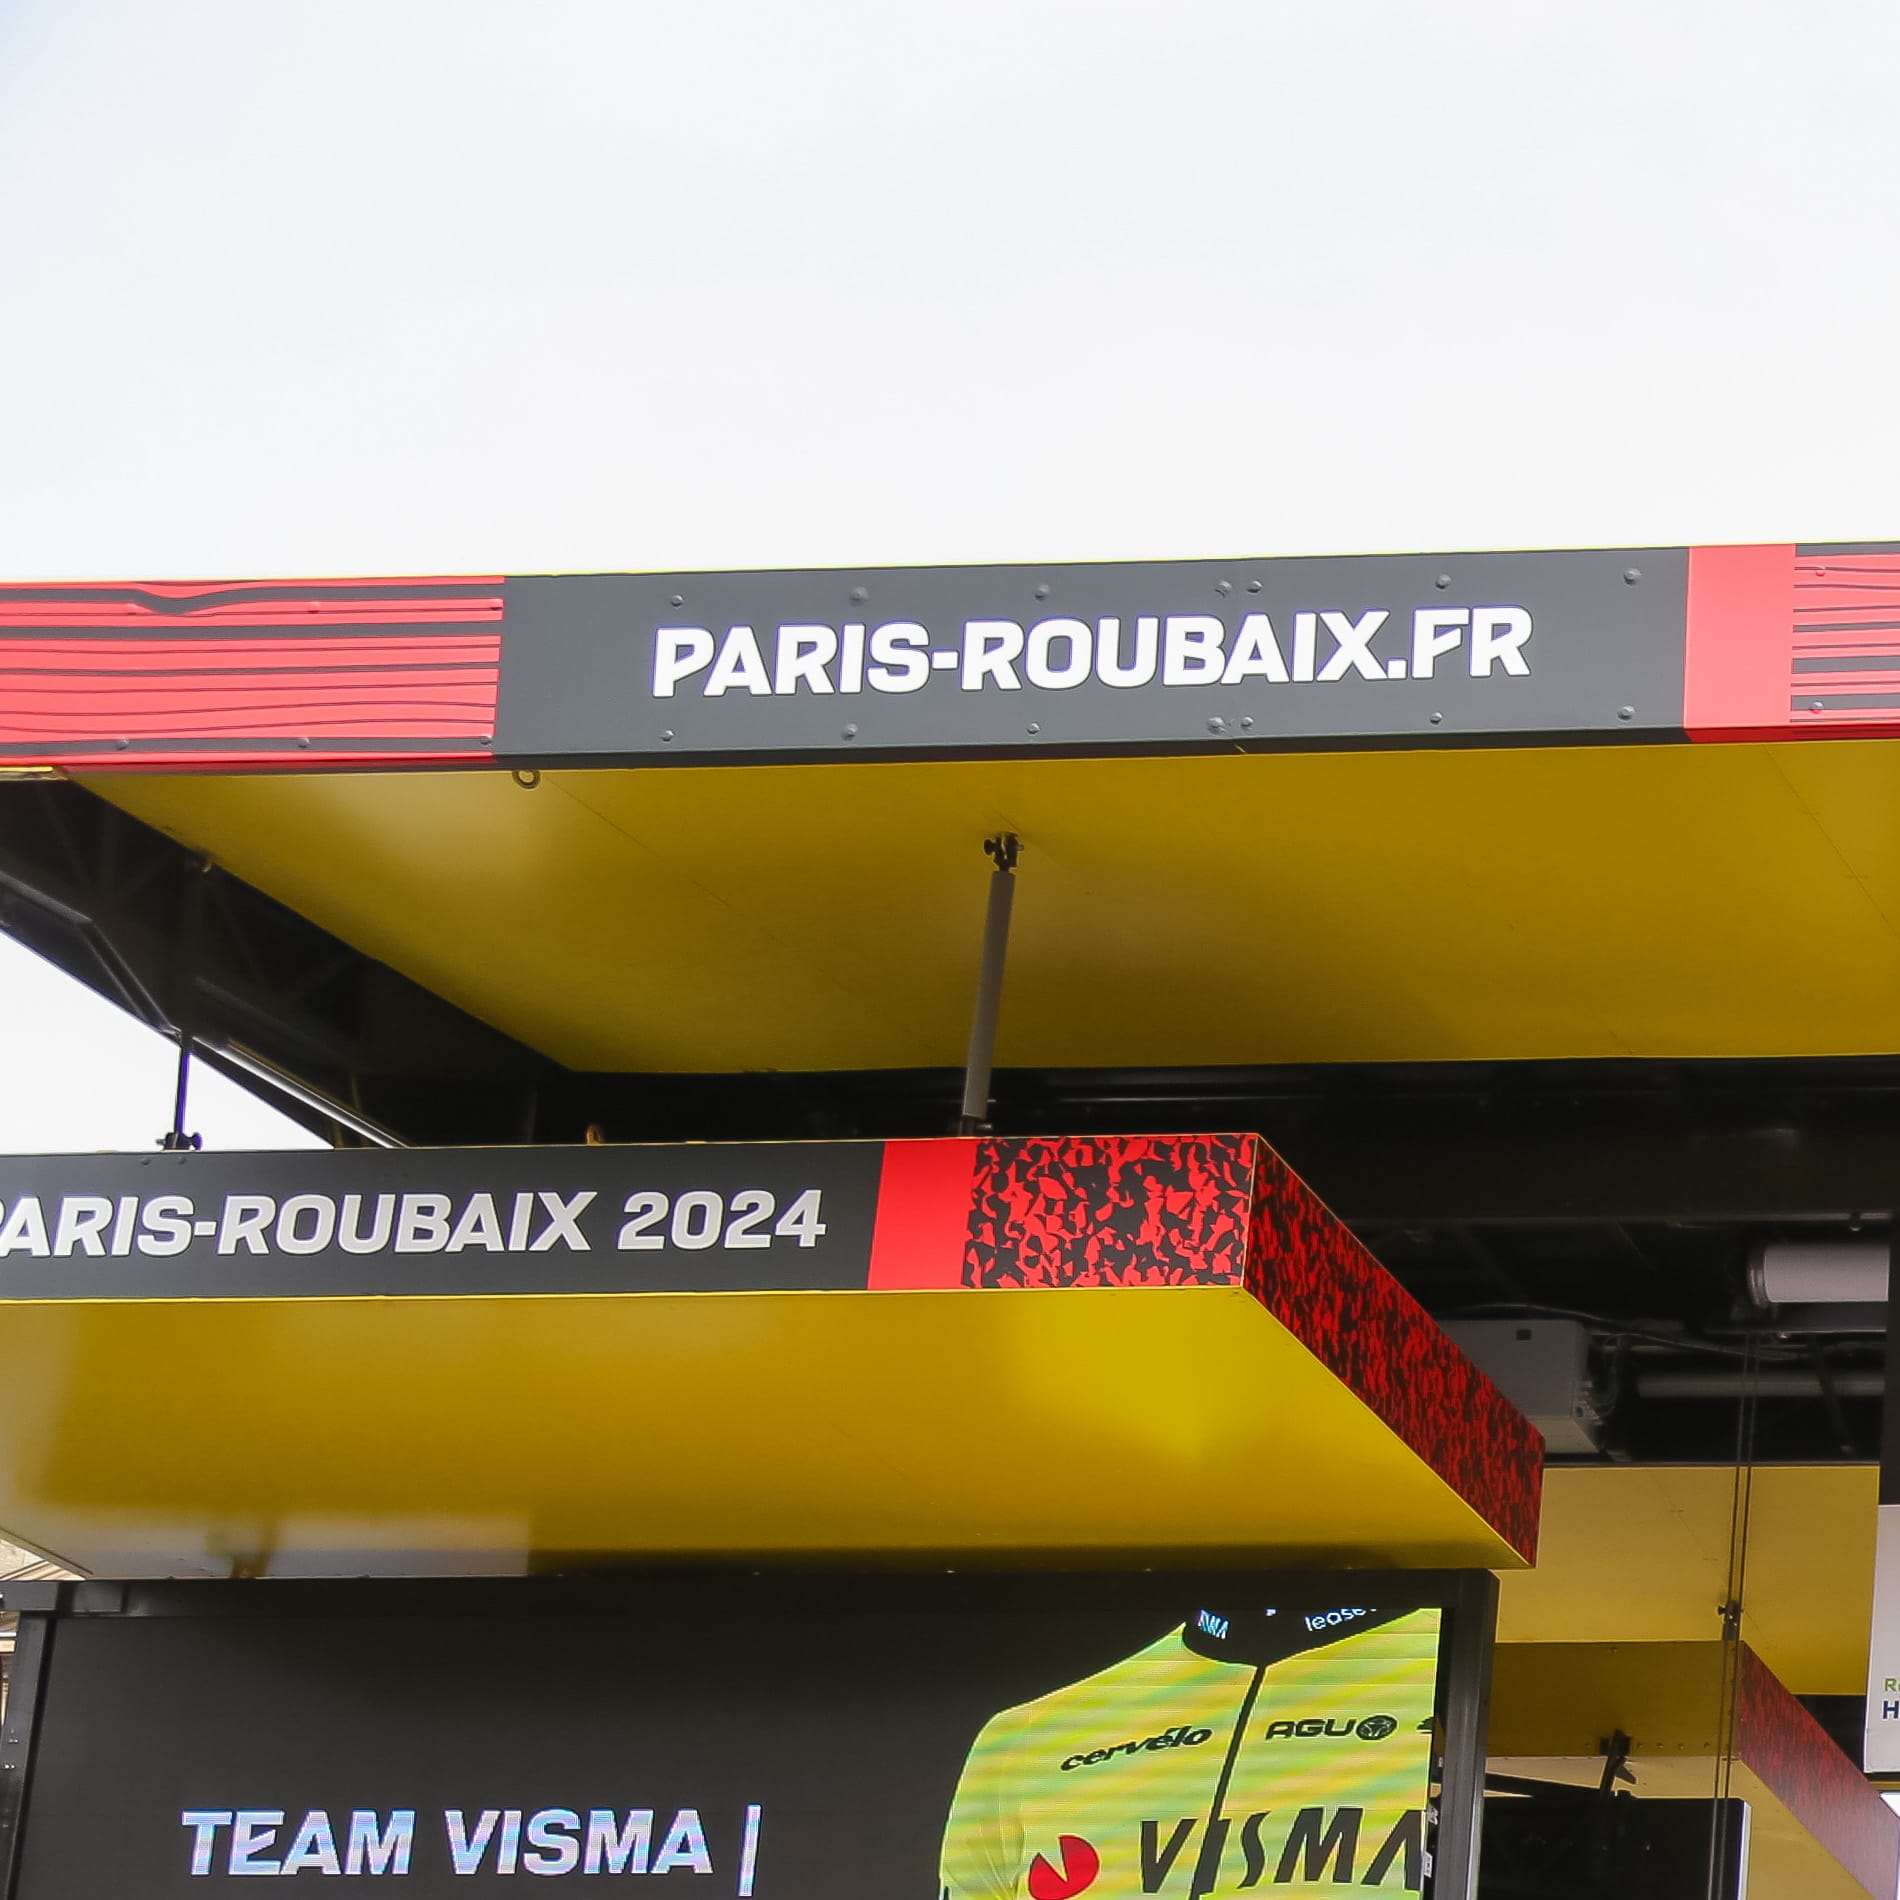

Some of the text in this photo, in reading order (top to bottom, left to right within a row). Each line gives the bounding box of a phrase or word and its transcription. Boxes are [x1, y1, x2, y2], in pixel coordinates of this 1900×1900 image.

[652, 606, 1534, 698] PARIS-ROUBAIX.FR
[0, 1189, 827, 1257] ARIS-ROUBAIX 2024
[1061, 1726, 1213, 1771] cervélo
[1265, 1718, 1357, 1740] AGU
[182, 1808, 416, 1876] TEAM
[443, 1808, 714, 1876] VISMA
[1139, 1806, 1428, 1896] VISMA
